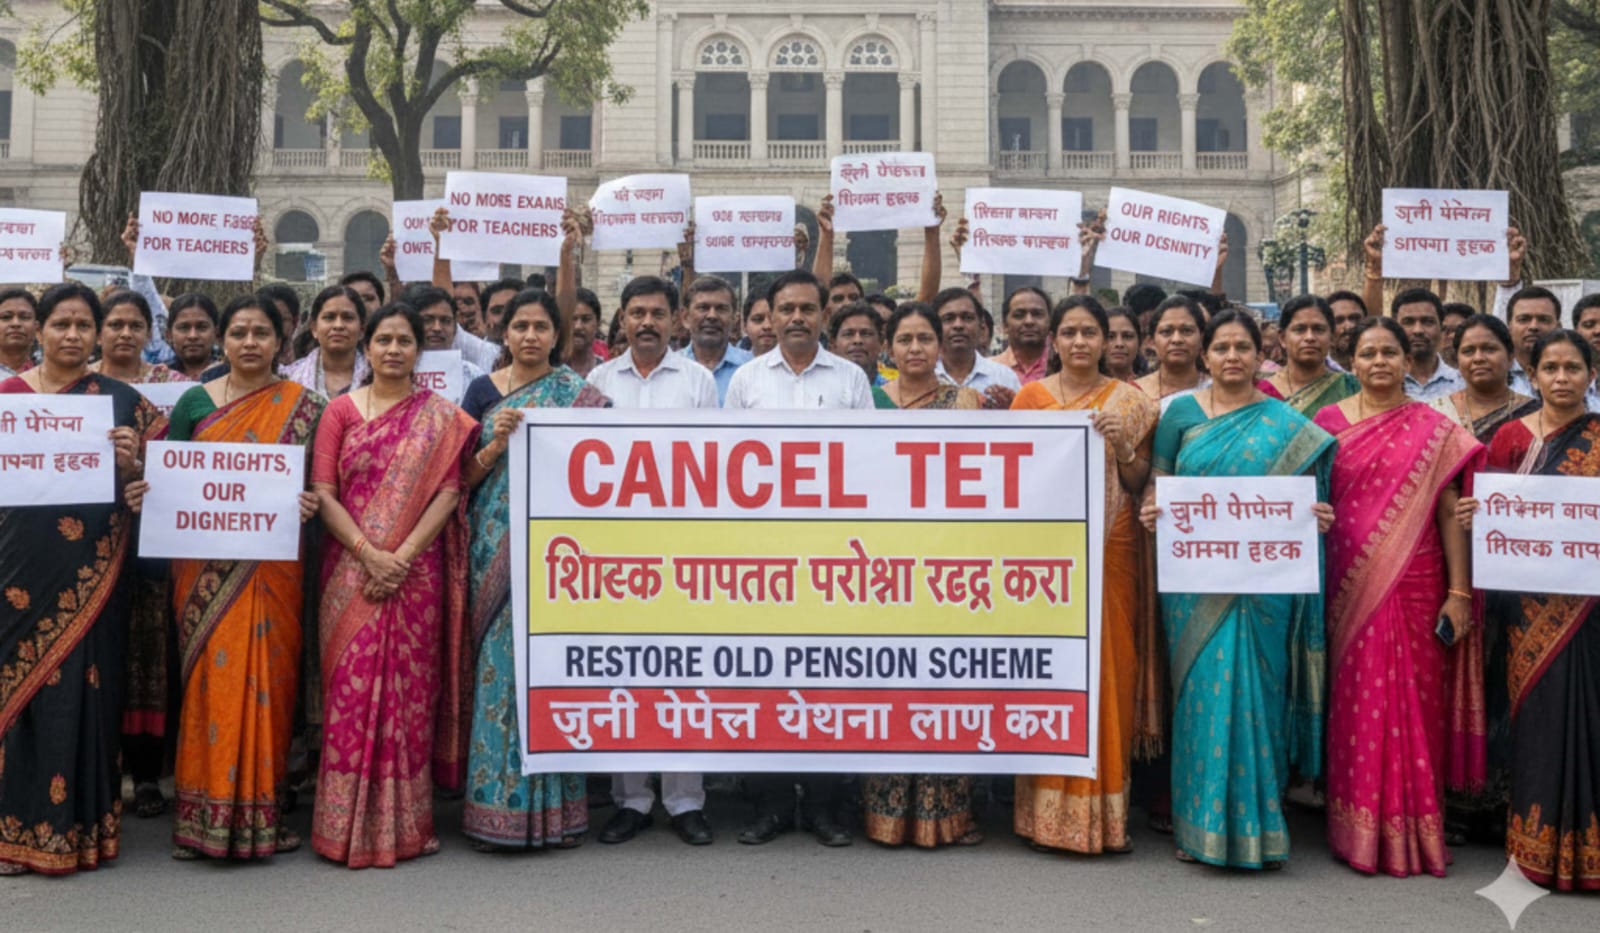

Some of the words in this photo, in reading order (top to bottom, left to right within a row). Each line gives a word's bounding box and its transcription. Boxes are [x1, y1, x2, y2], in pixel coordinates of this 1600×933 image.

[451, 192, 471, 206] NO
[152, 210, 174, 225] NO
[177, 211, 218, 227] MORE
[1121, 202, 1154, 220] OUR
[176, 238, 249, 255] TEACHERS
[1110, 228, 1142, 245] OUR
[163, 449, 206, 470] OUR
[212, 451, 291, 476] RIGHTS,
[567, 437, 869, 509] CANCEL
[895, 442, 1035, 509] TET
[202, 482, 246, 502] OUR
[175, 510, 278, 533] DIGNERTY
[1003, 559, 1073, 604] करा
[566, 645, 703, 678] RESTORE
[713, 646, 774, 678] OLD
[784, 646, 917, 680] PENSION
[928, 647, 1053, 680] SCHEME
[549, 687, 639, 750] जुनी
[1005, 704, 1074, 741] करा
